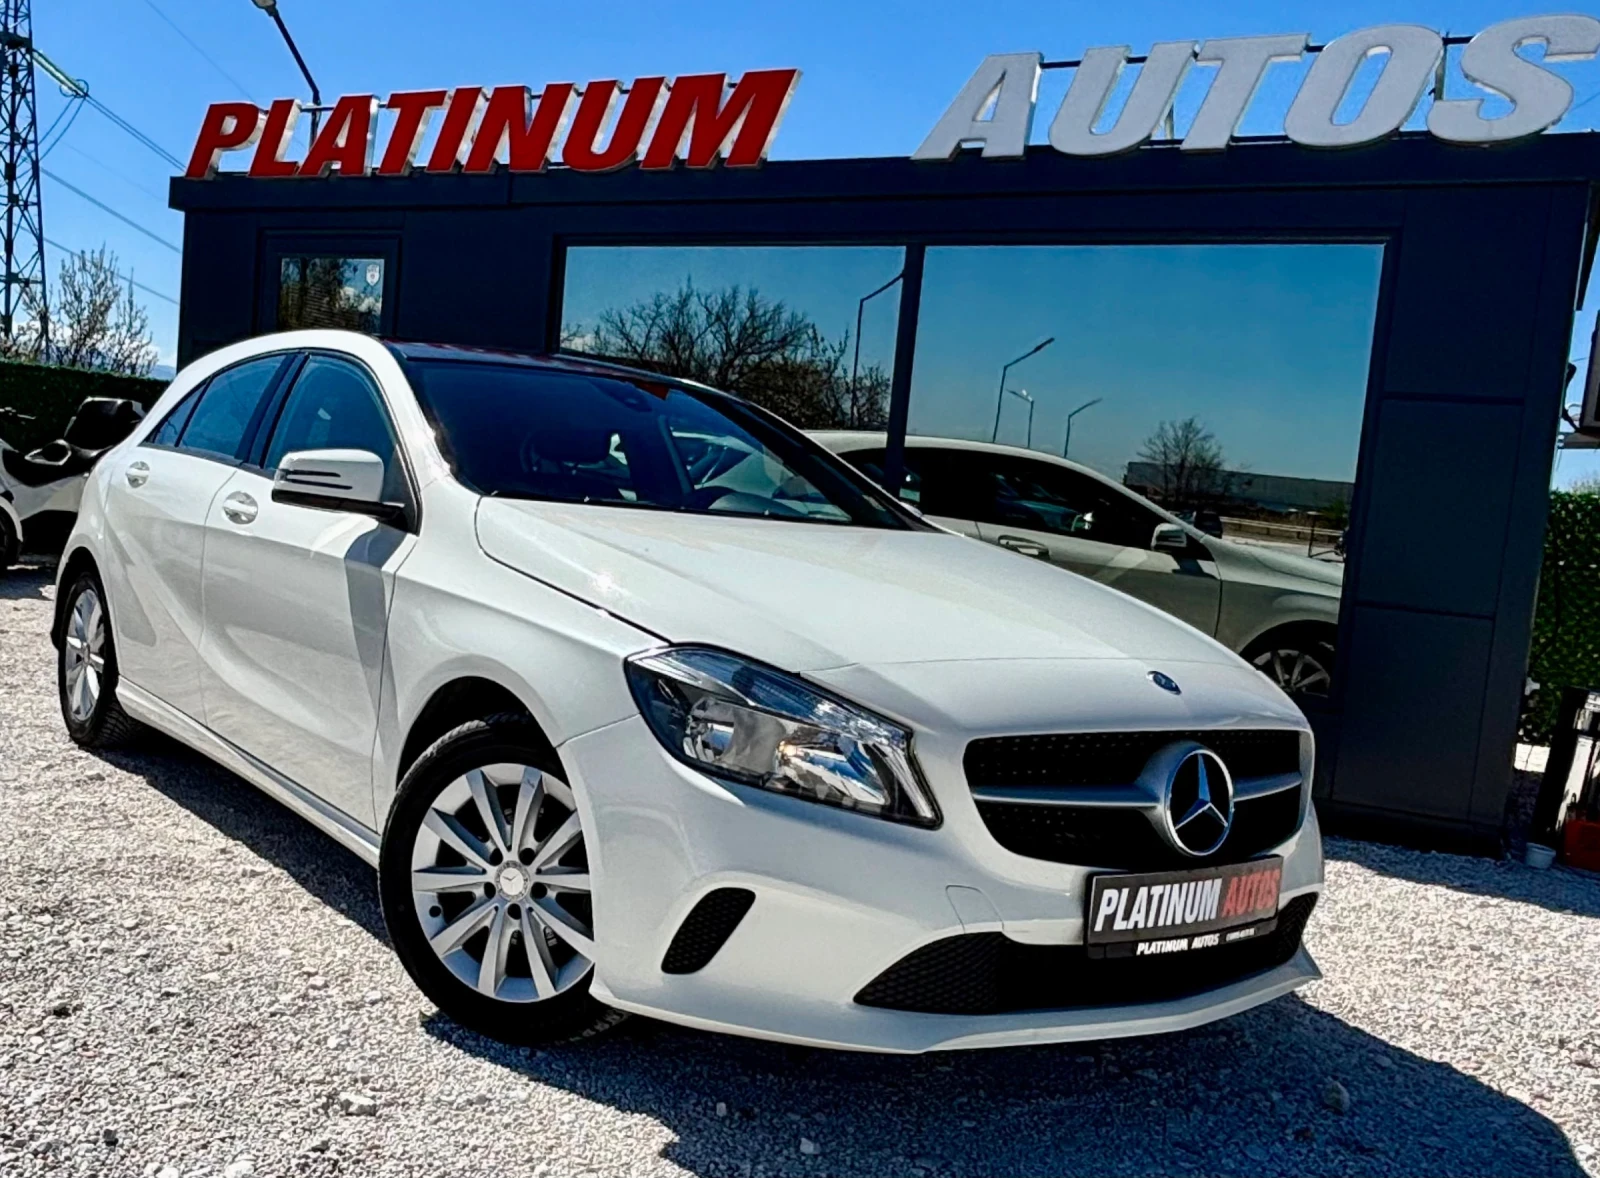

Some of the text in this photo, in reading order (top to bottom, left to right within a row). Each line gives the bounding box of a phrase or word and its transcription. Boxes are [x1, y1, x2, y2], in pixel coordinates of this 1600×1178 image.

[186, 14, 1600, 180] PLATINUM AUTOS
[1094, 869, 1281, 932] PLATINUM AUTOS
[1136, 938, 1188, 955] PLATINUM
[1191, 933, 1220, 949] AUTOS
